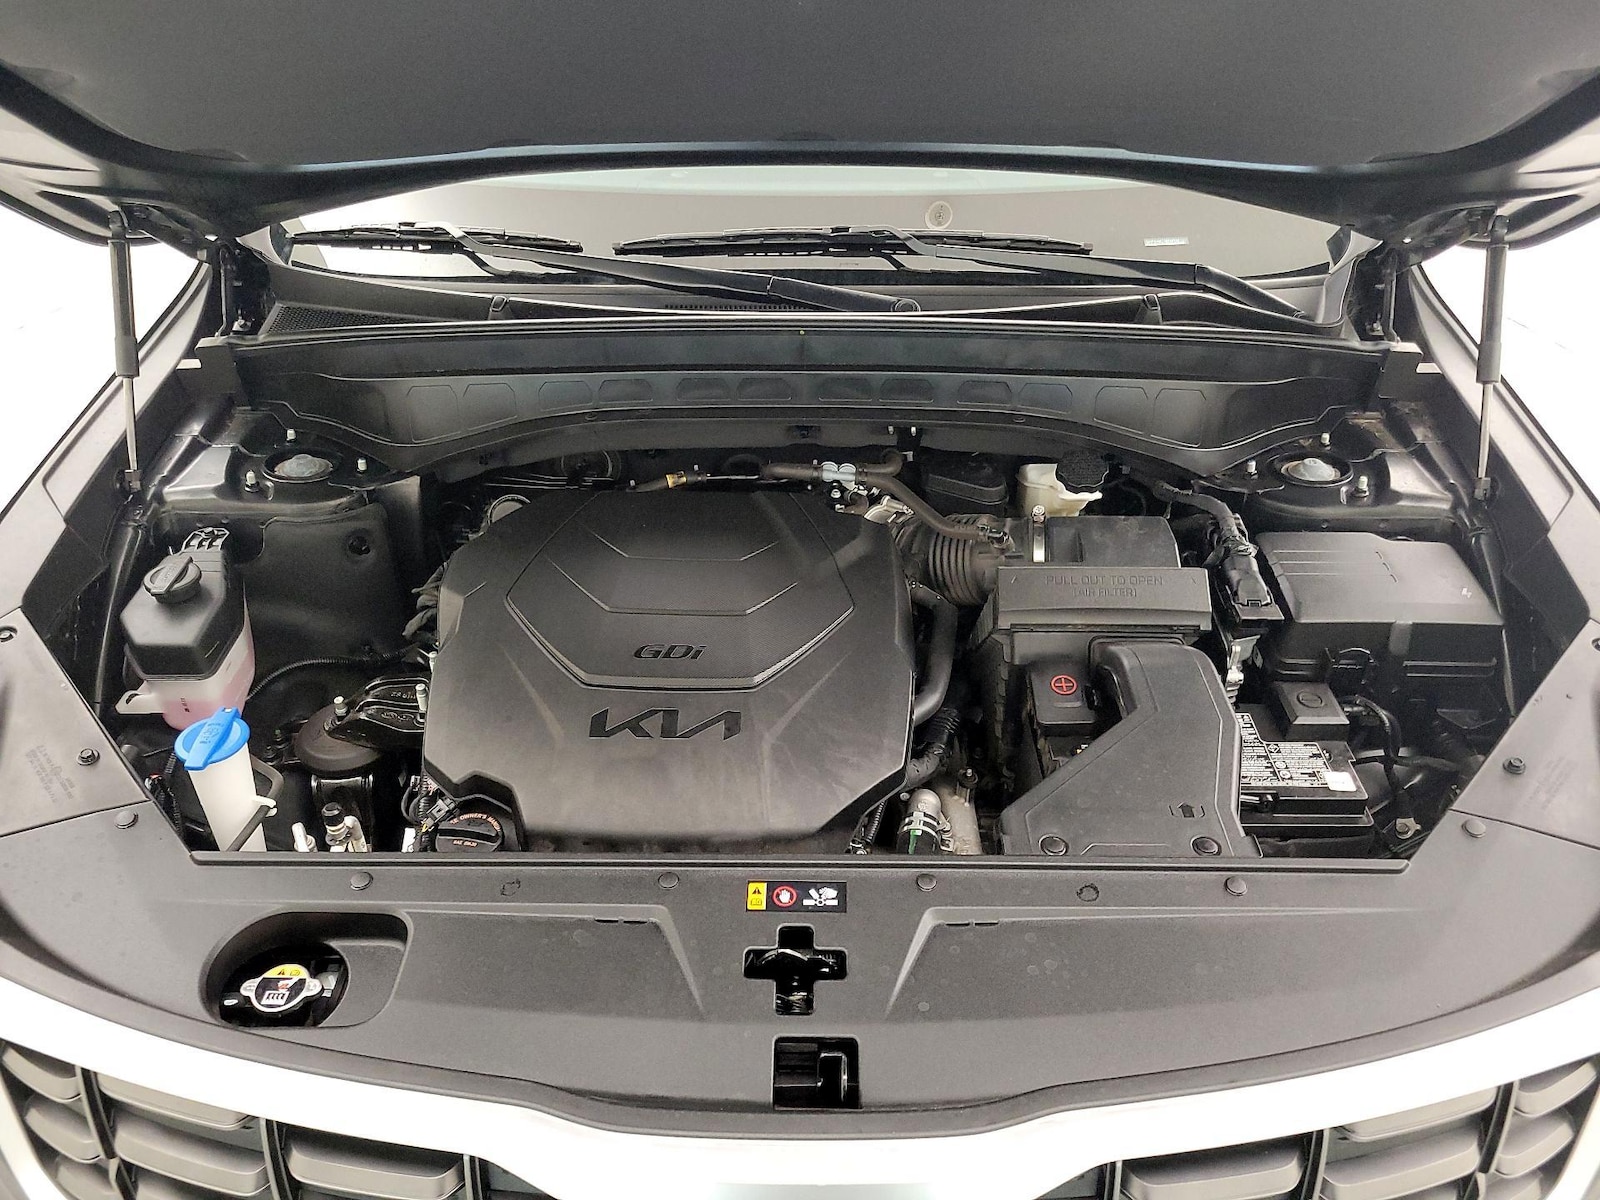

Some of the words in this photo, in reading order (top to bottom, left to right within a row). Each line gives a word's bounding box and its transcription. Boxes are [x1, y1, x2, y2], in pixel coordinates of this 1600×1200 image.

[1046, 575, 1078, 585] PULL
[1081, 575, 1106, 585] OUT
[1109, 575, 1126, 585] TO
[1129, 575, 1163, 585] OPEN
[634, 644, 707, 660] GDi
[589, 707, 741, 742] KIA
